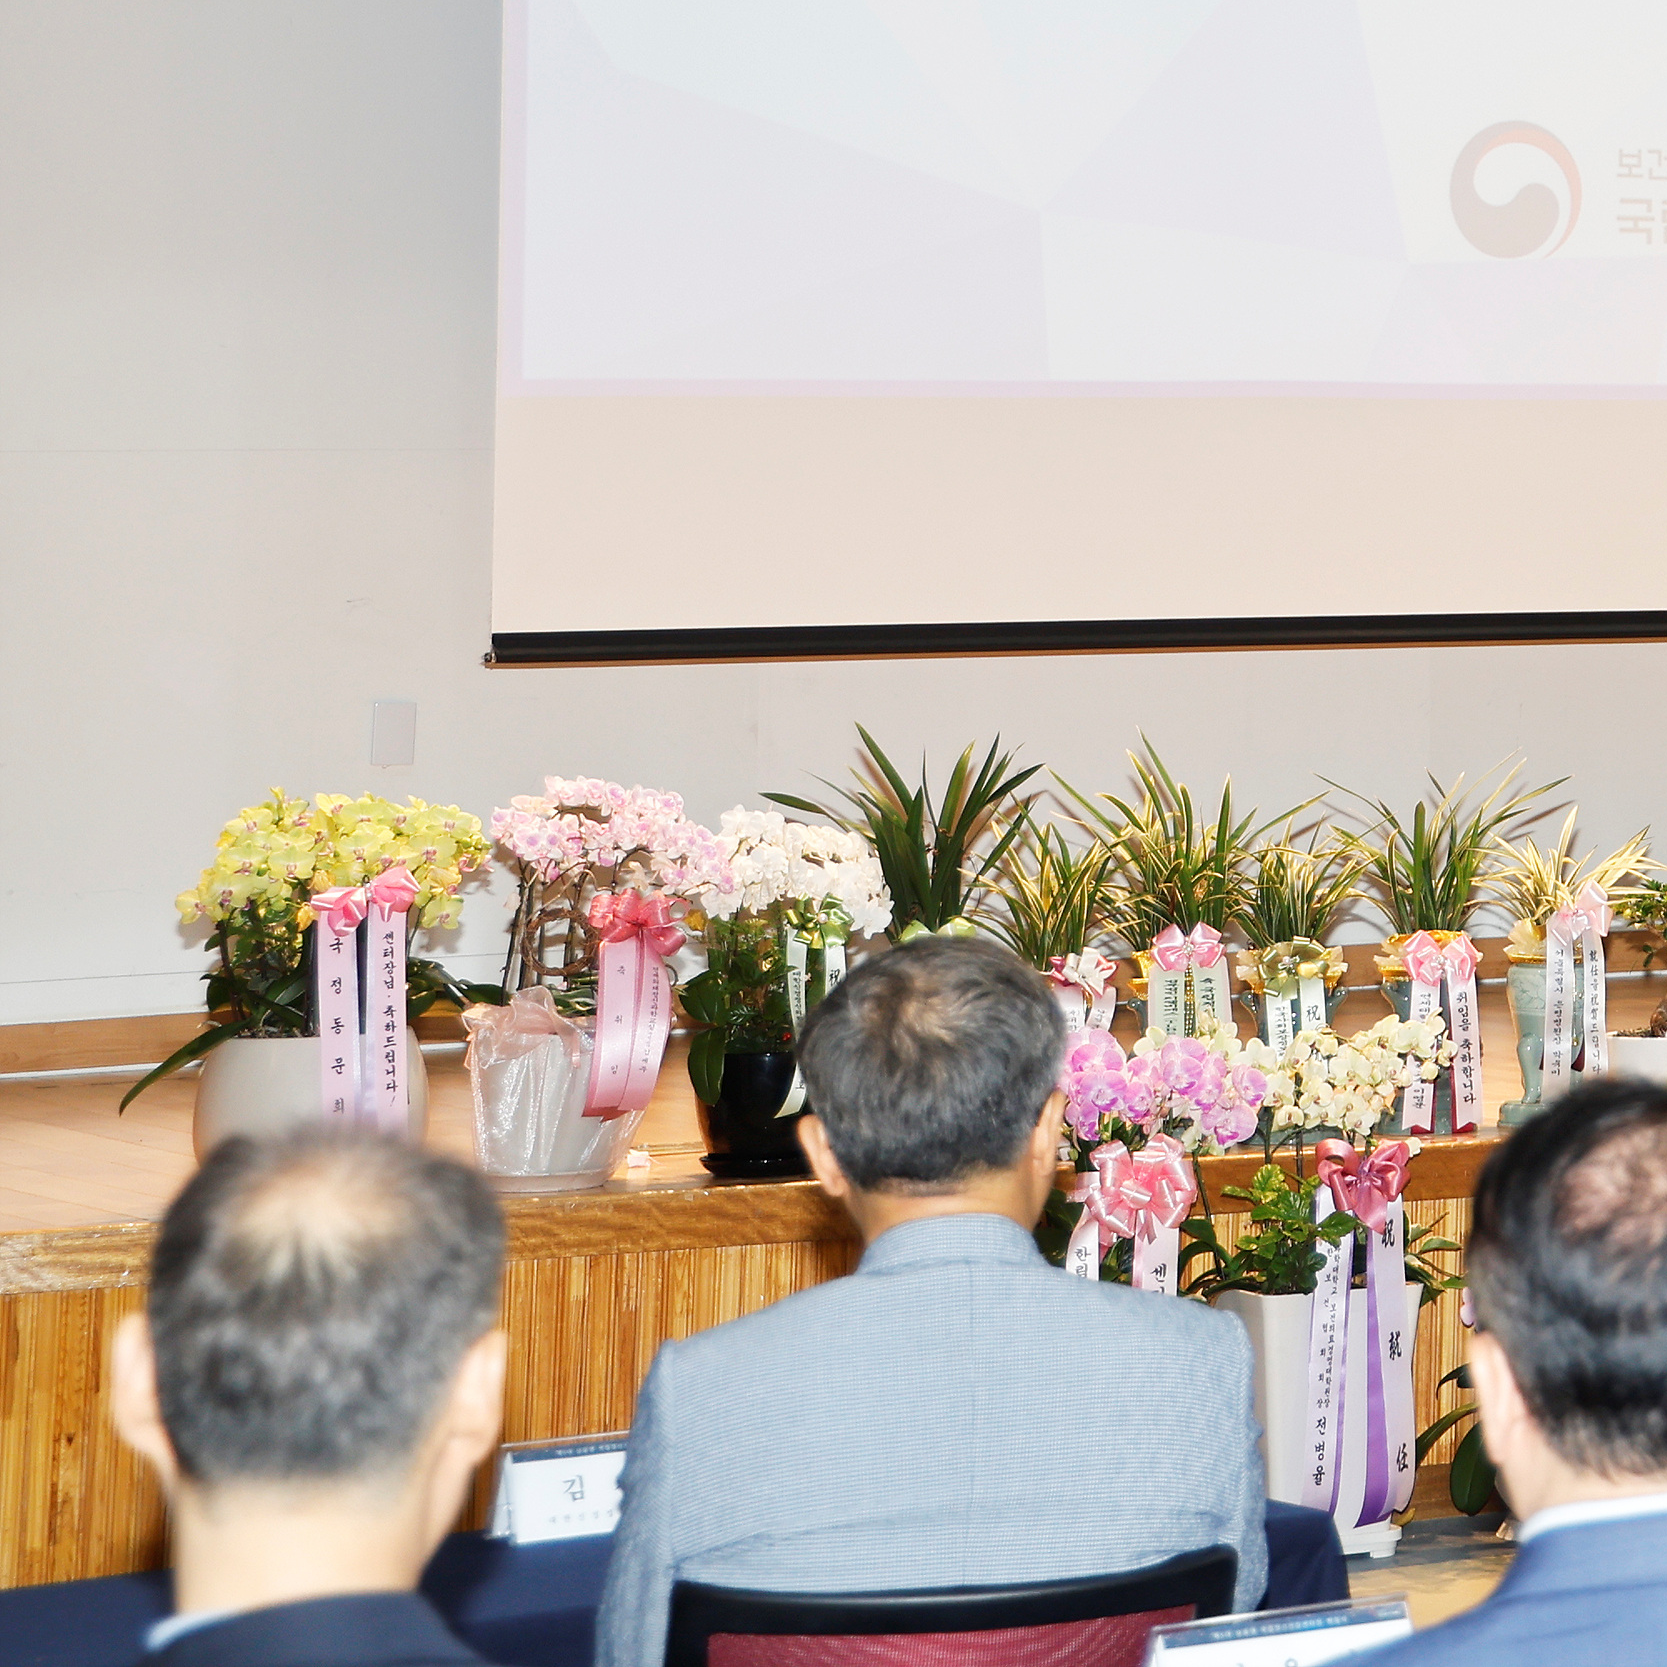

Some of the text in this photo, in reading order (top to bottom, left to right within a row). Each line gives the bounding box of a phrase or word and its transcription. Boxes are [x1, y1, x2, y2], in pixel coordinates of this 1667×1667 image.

[1306, 1004, 1320, 1022] 祝
[1456, 991, 1476, 1105] 취임을 축하합니다
